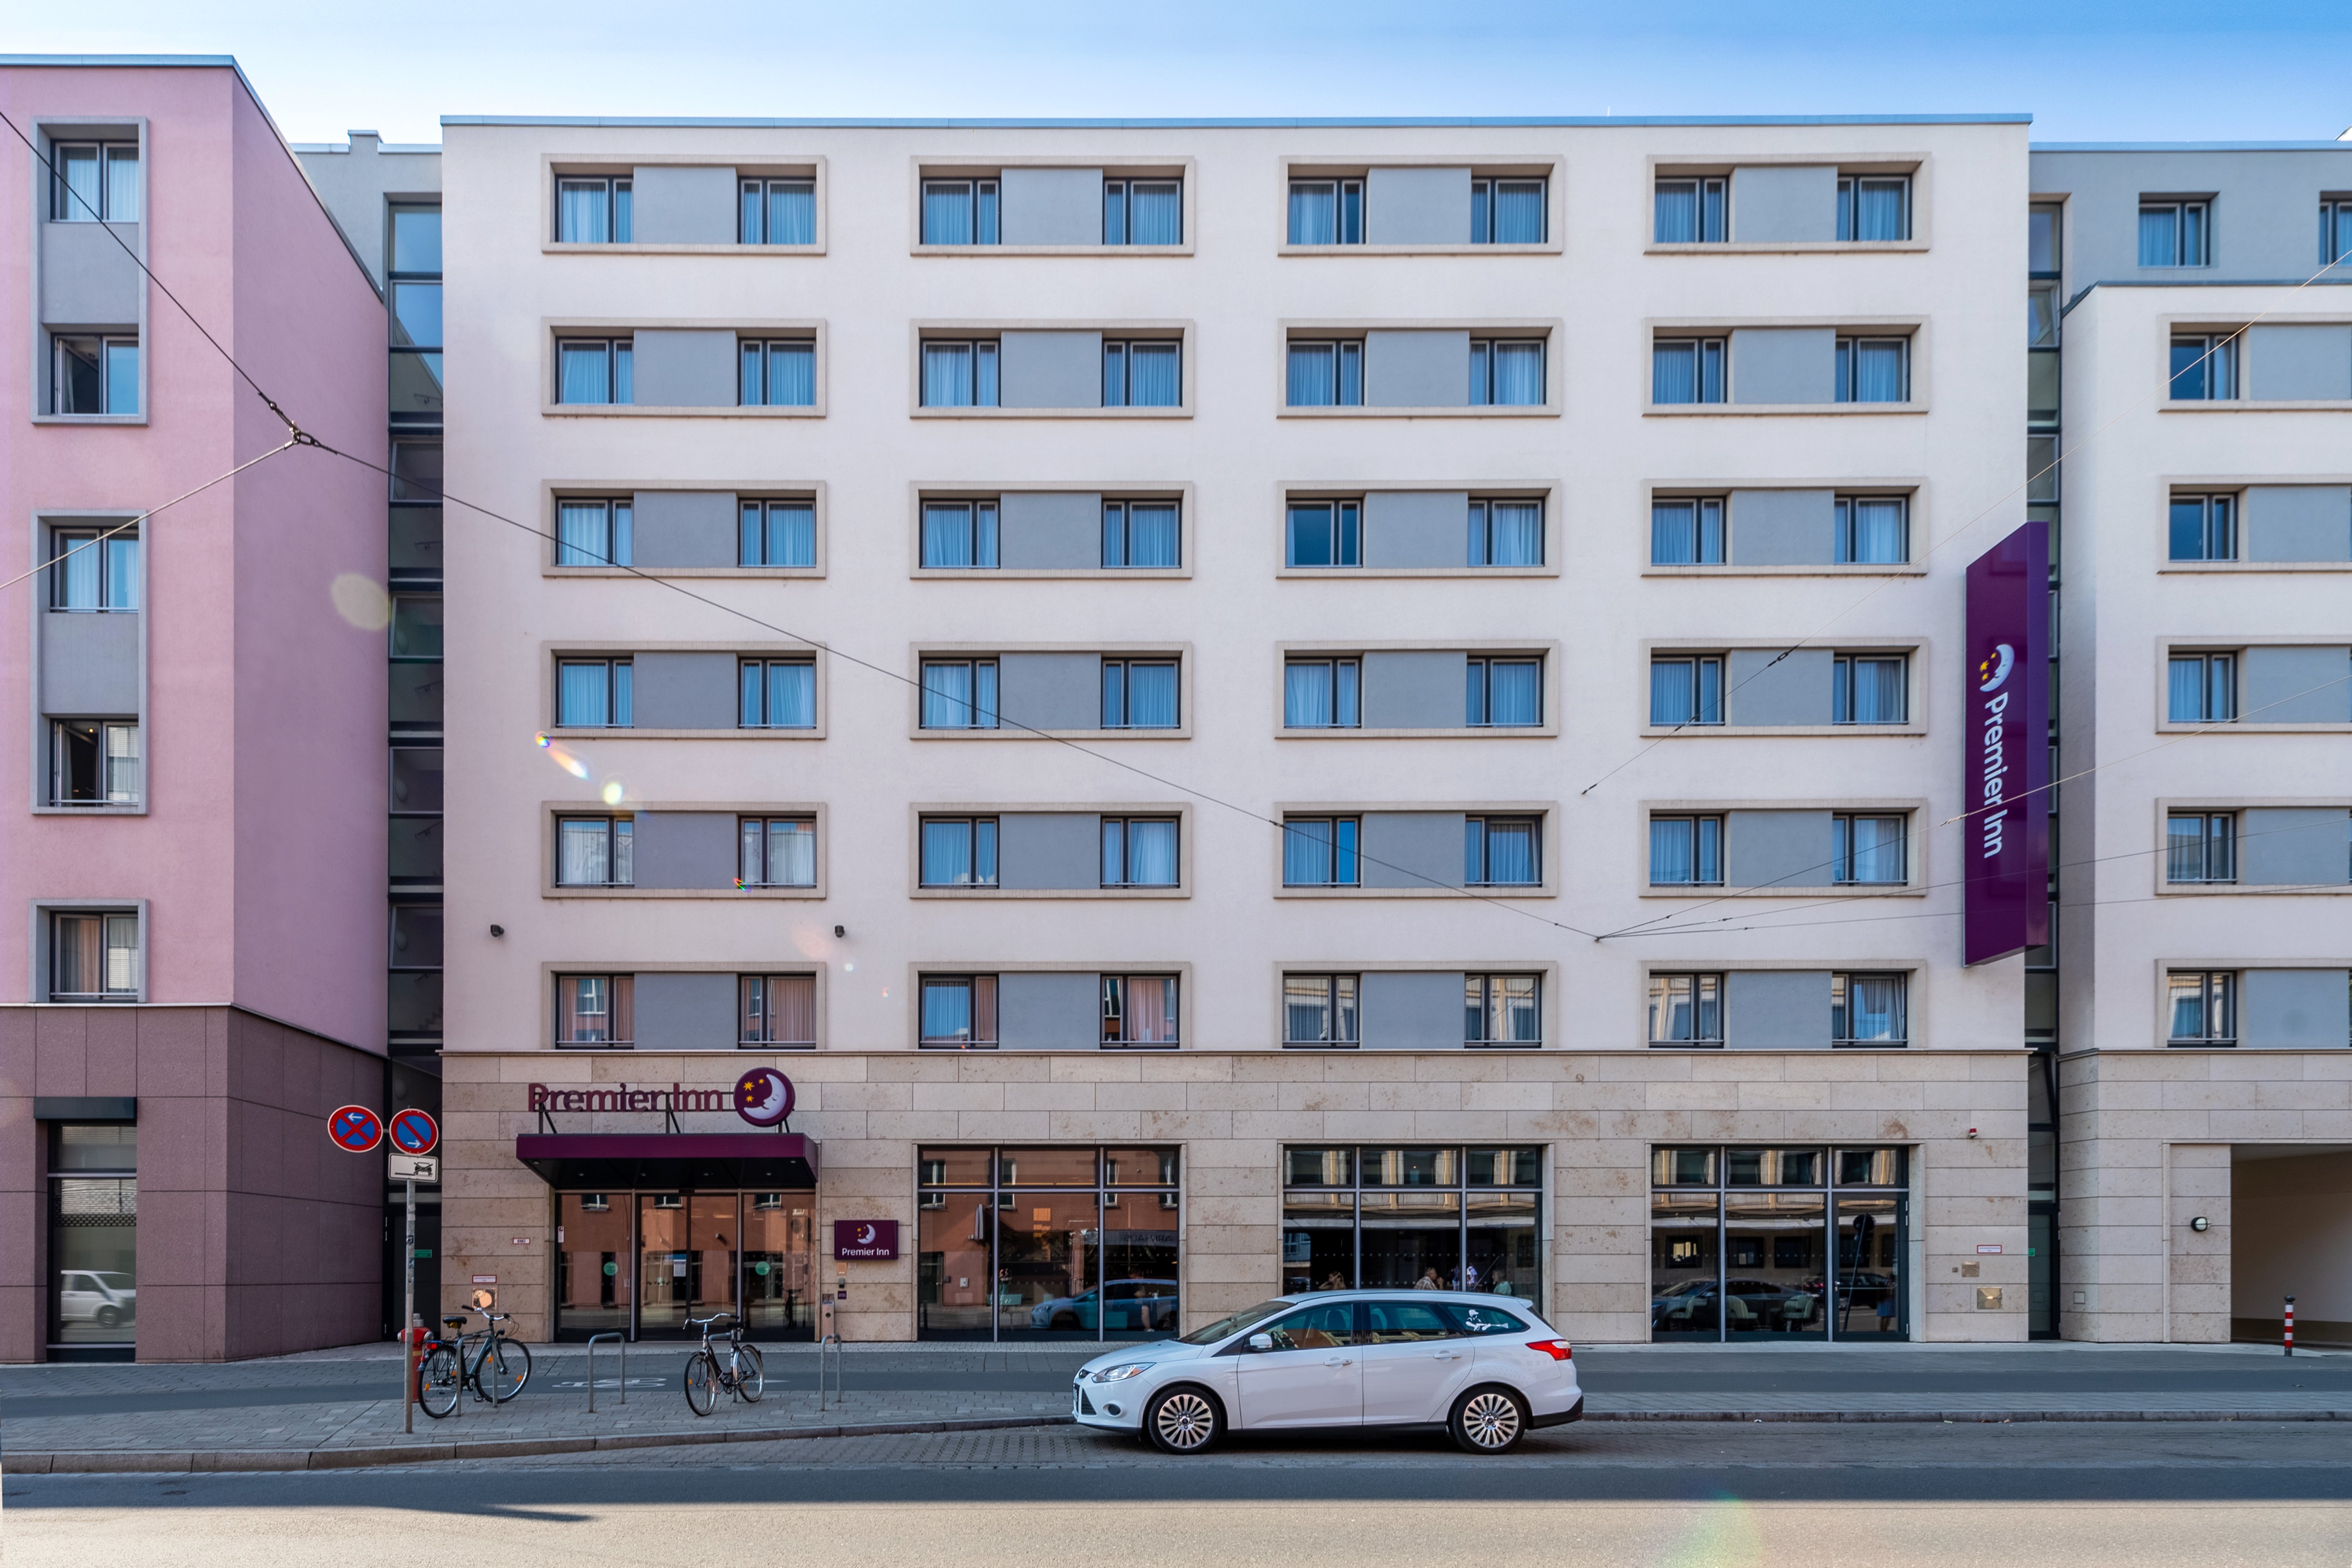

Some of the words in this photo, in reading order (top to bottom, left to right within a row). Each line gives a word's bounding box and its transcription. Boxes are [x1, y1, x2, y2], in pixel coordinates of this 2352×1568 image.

[1984, 692, 2008, 806] Premier
[1984, 809, 2008, 858] Inn
[528, 1083, 663, 1112] Premier
[673, 1083, 722, 1112] Inn
[842, 1247, 875, 1256] Premier
[877, 1247, 889, 1256] Inn
